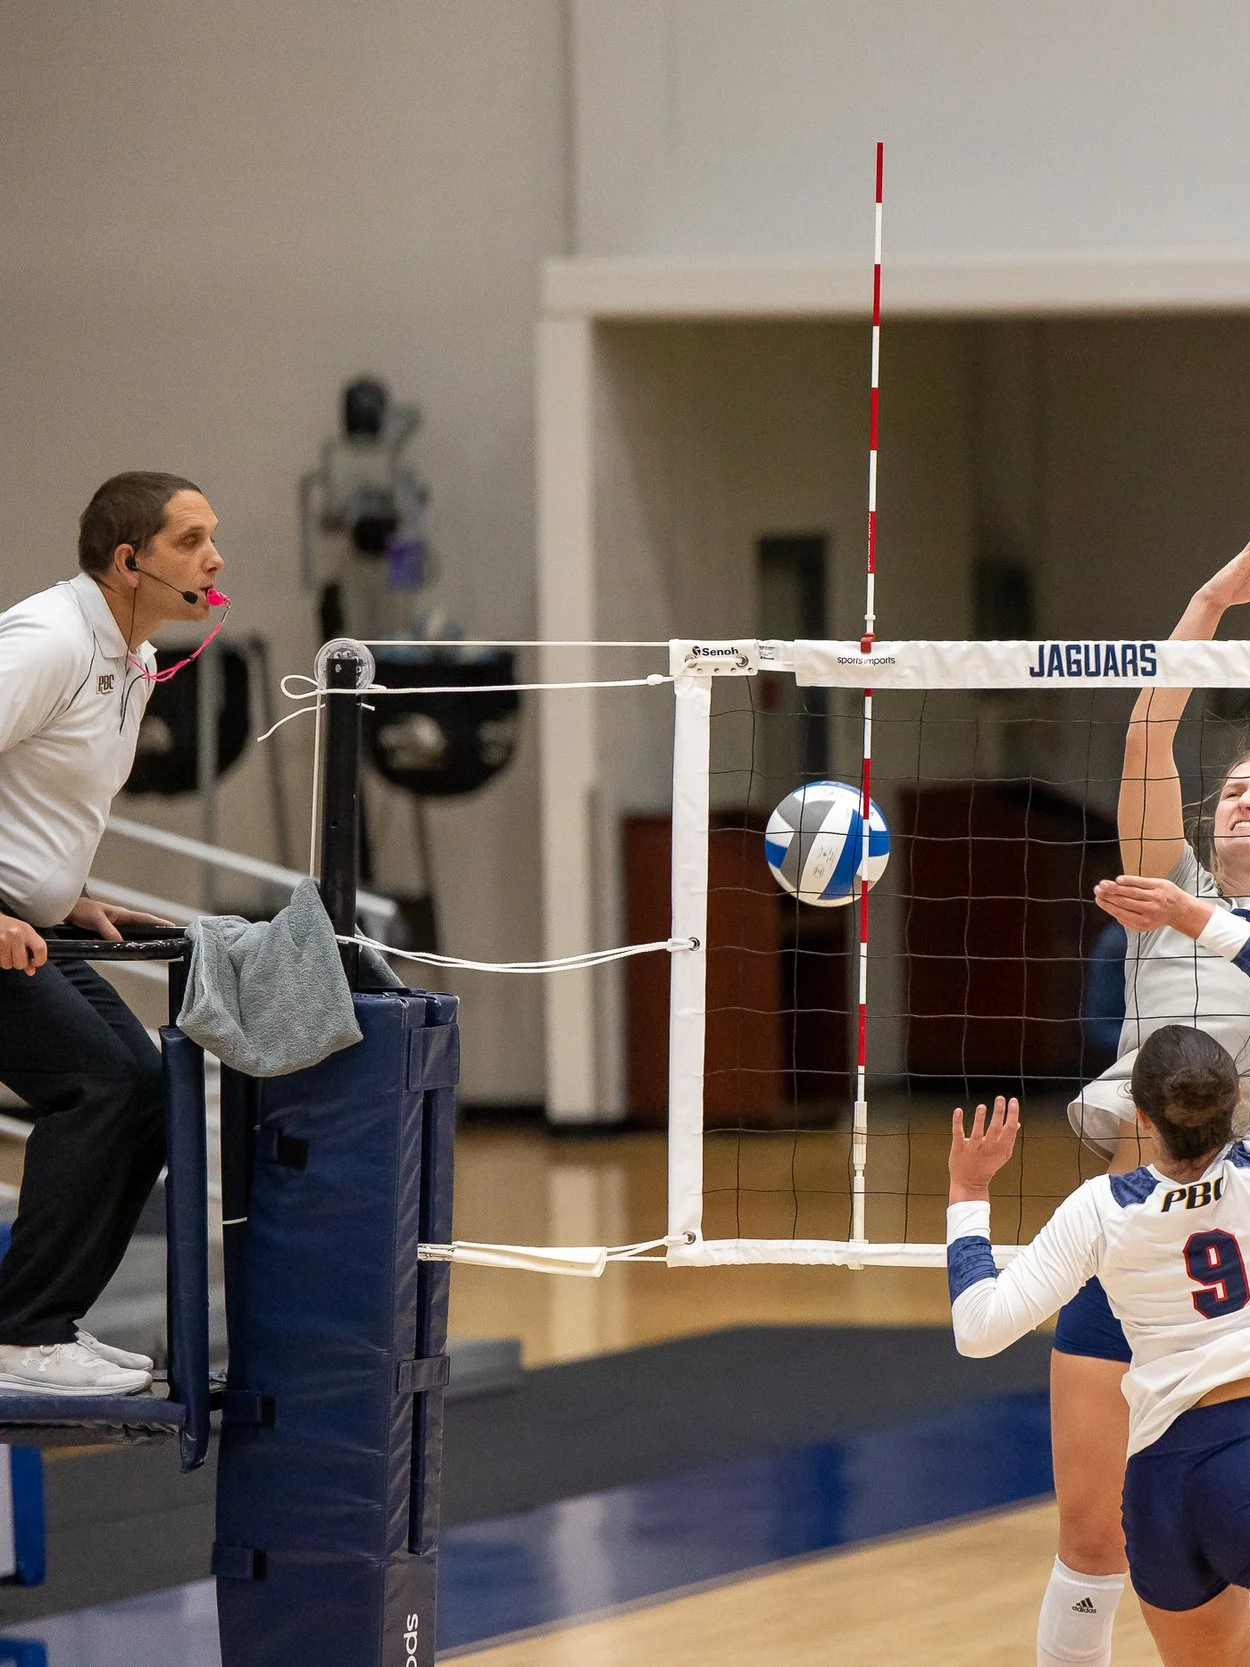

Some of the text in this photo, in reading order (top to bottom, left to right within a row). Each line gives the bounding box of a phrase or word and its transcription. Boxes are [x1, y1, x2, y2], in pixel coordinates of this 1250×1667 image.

[702, 647, 739, 656] Senoh
[837, 656, 896, 666] sports imports
[1029, 643, 1157, 678] JAGUARS
[96, 674, 115, 694] PBC
[1182, 1228, 1250, 1320] 9
